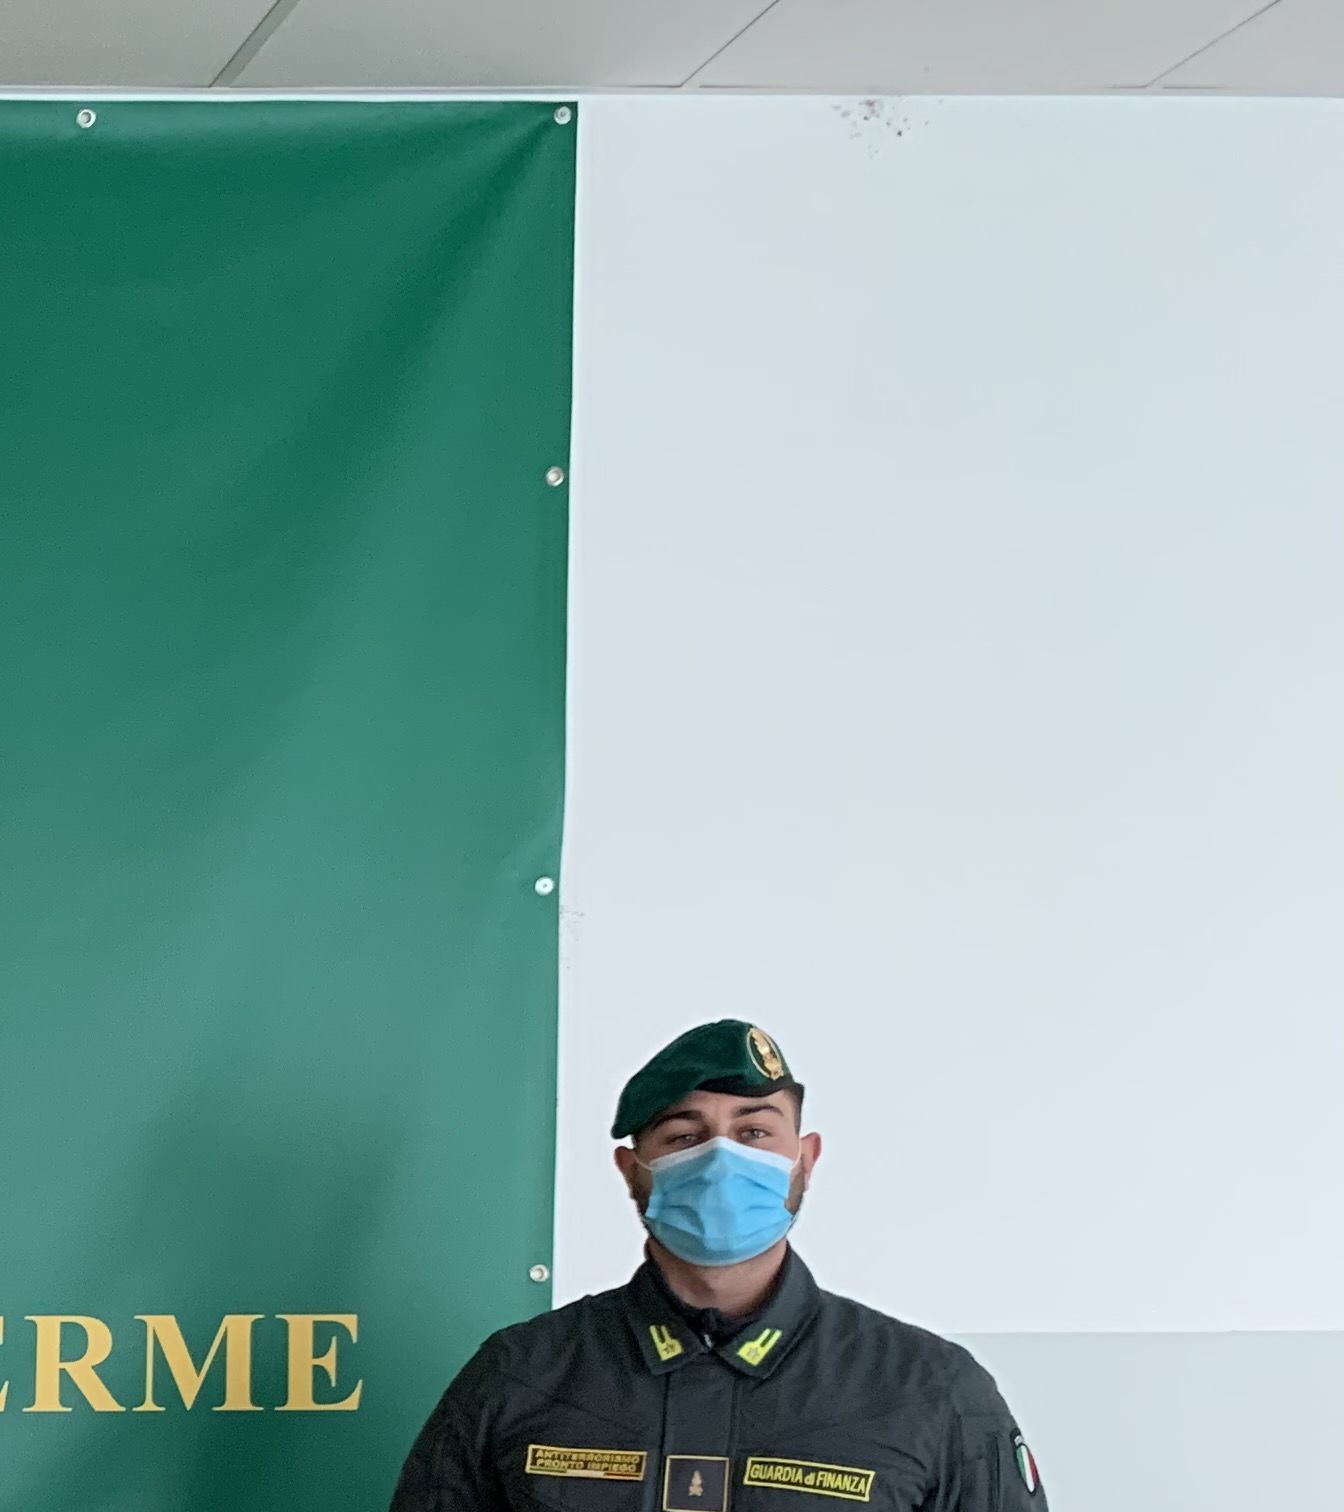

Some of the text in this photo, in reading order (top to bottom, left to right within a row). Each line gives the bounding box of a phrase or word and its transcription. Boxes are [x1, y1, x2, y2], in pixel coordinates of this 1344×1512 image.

[536, 1458, 637, 1473] PRONTO IMPIEGO
[750, 1464, 803, 1485] GUARDIA
[815, 1471, 866, 1495] FINANZA
